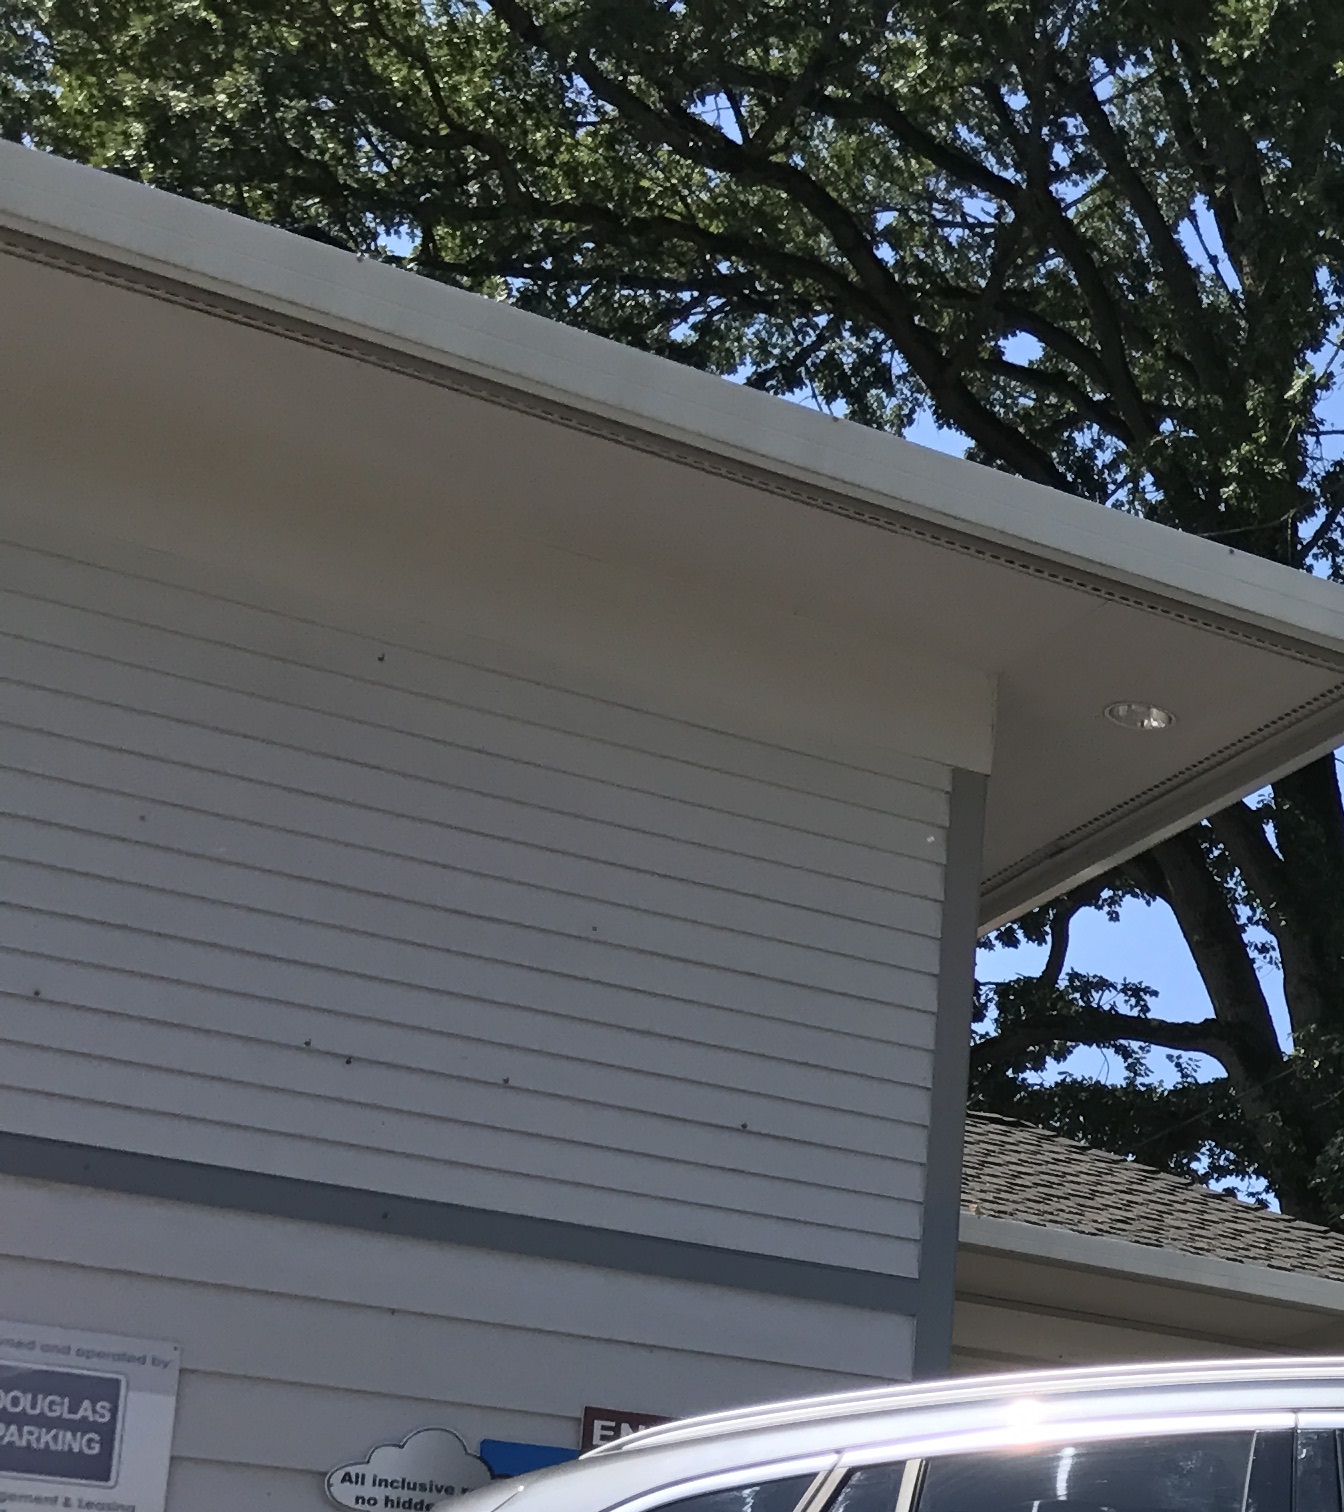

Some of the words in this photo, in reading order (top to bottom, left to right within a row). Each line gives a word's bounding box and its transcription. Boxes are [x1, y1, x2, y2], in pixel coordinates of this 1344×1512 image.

[340, 1471, 366, 1486] All
[372, 1474, 456, 1496] inclusive
[355, 1495, 378, 1507] no
